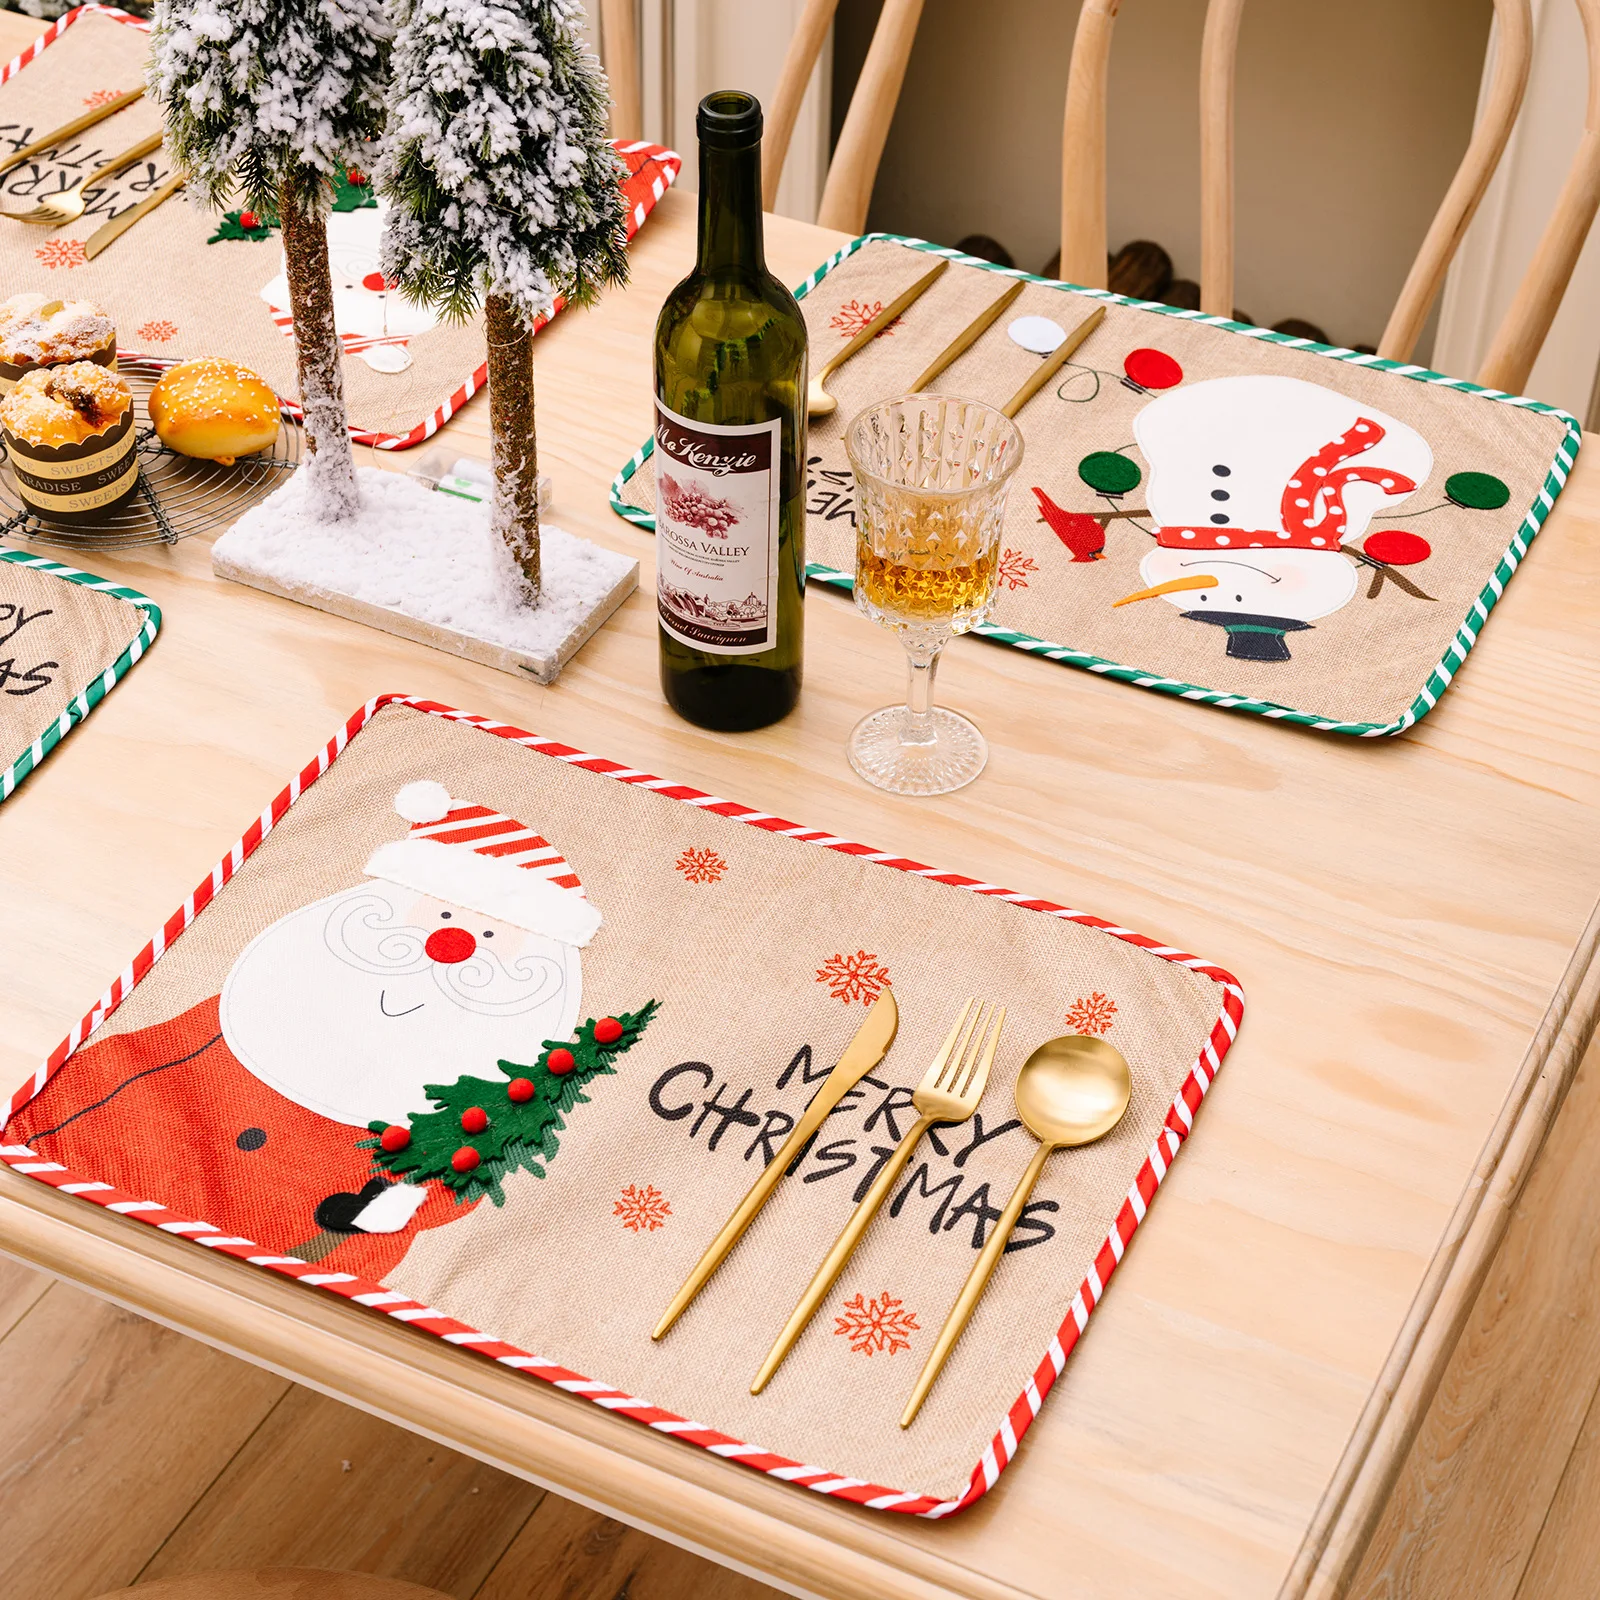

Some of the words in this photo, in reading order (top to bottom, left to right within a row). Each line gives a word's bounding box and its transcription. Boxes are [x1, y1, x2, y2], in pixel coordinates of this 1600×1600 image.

[51, 453, 114, 476] SWEETS
[68, 480, 127, 509] SWEETS
[700, 541, 750, 557] VALLEY
